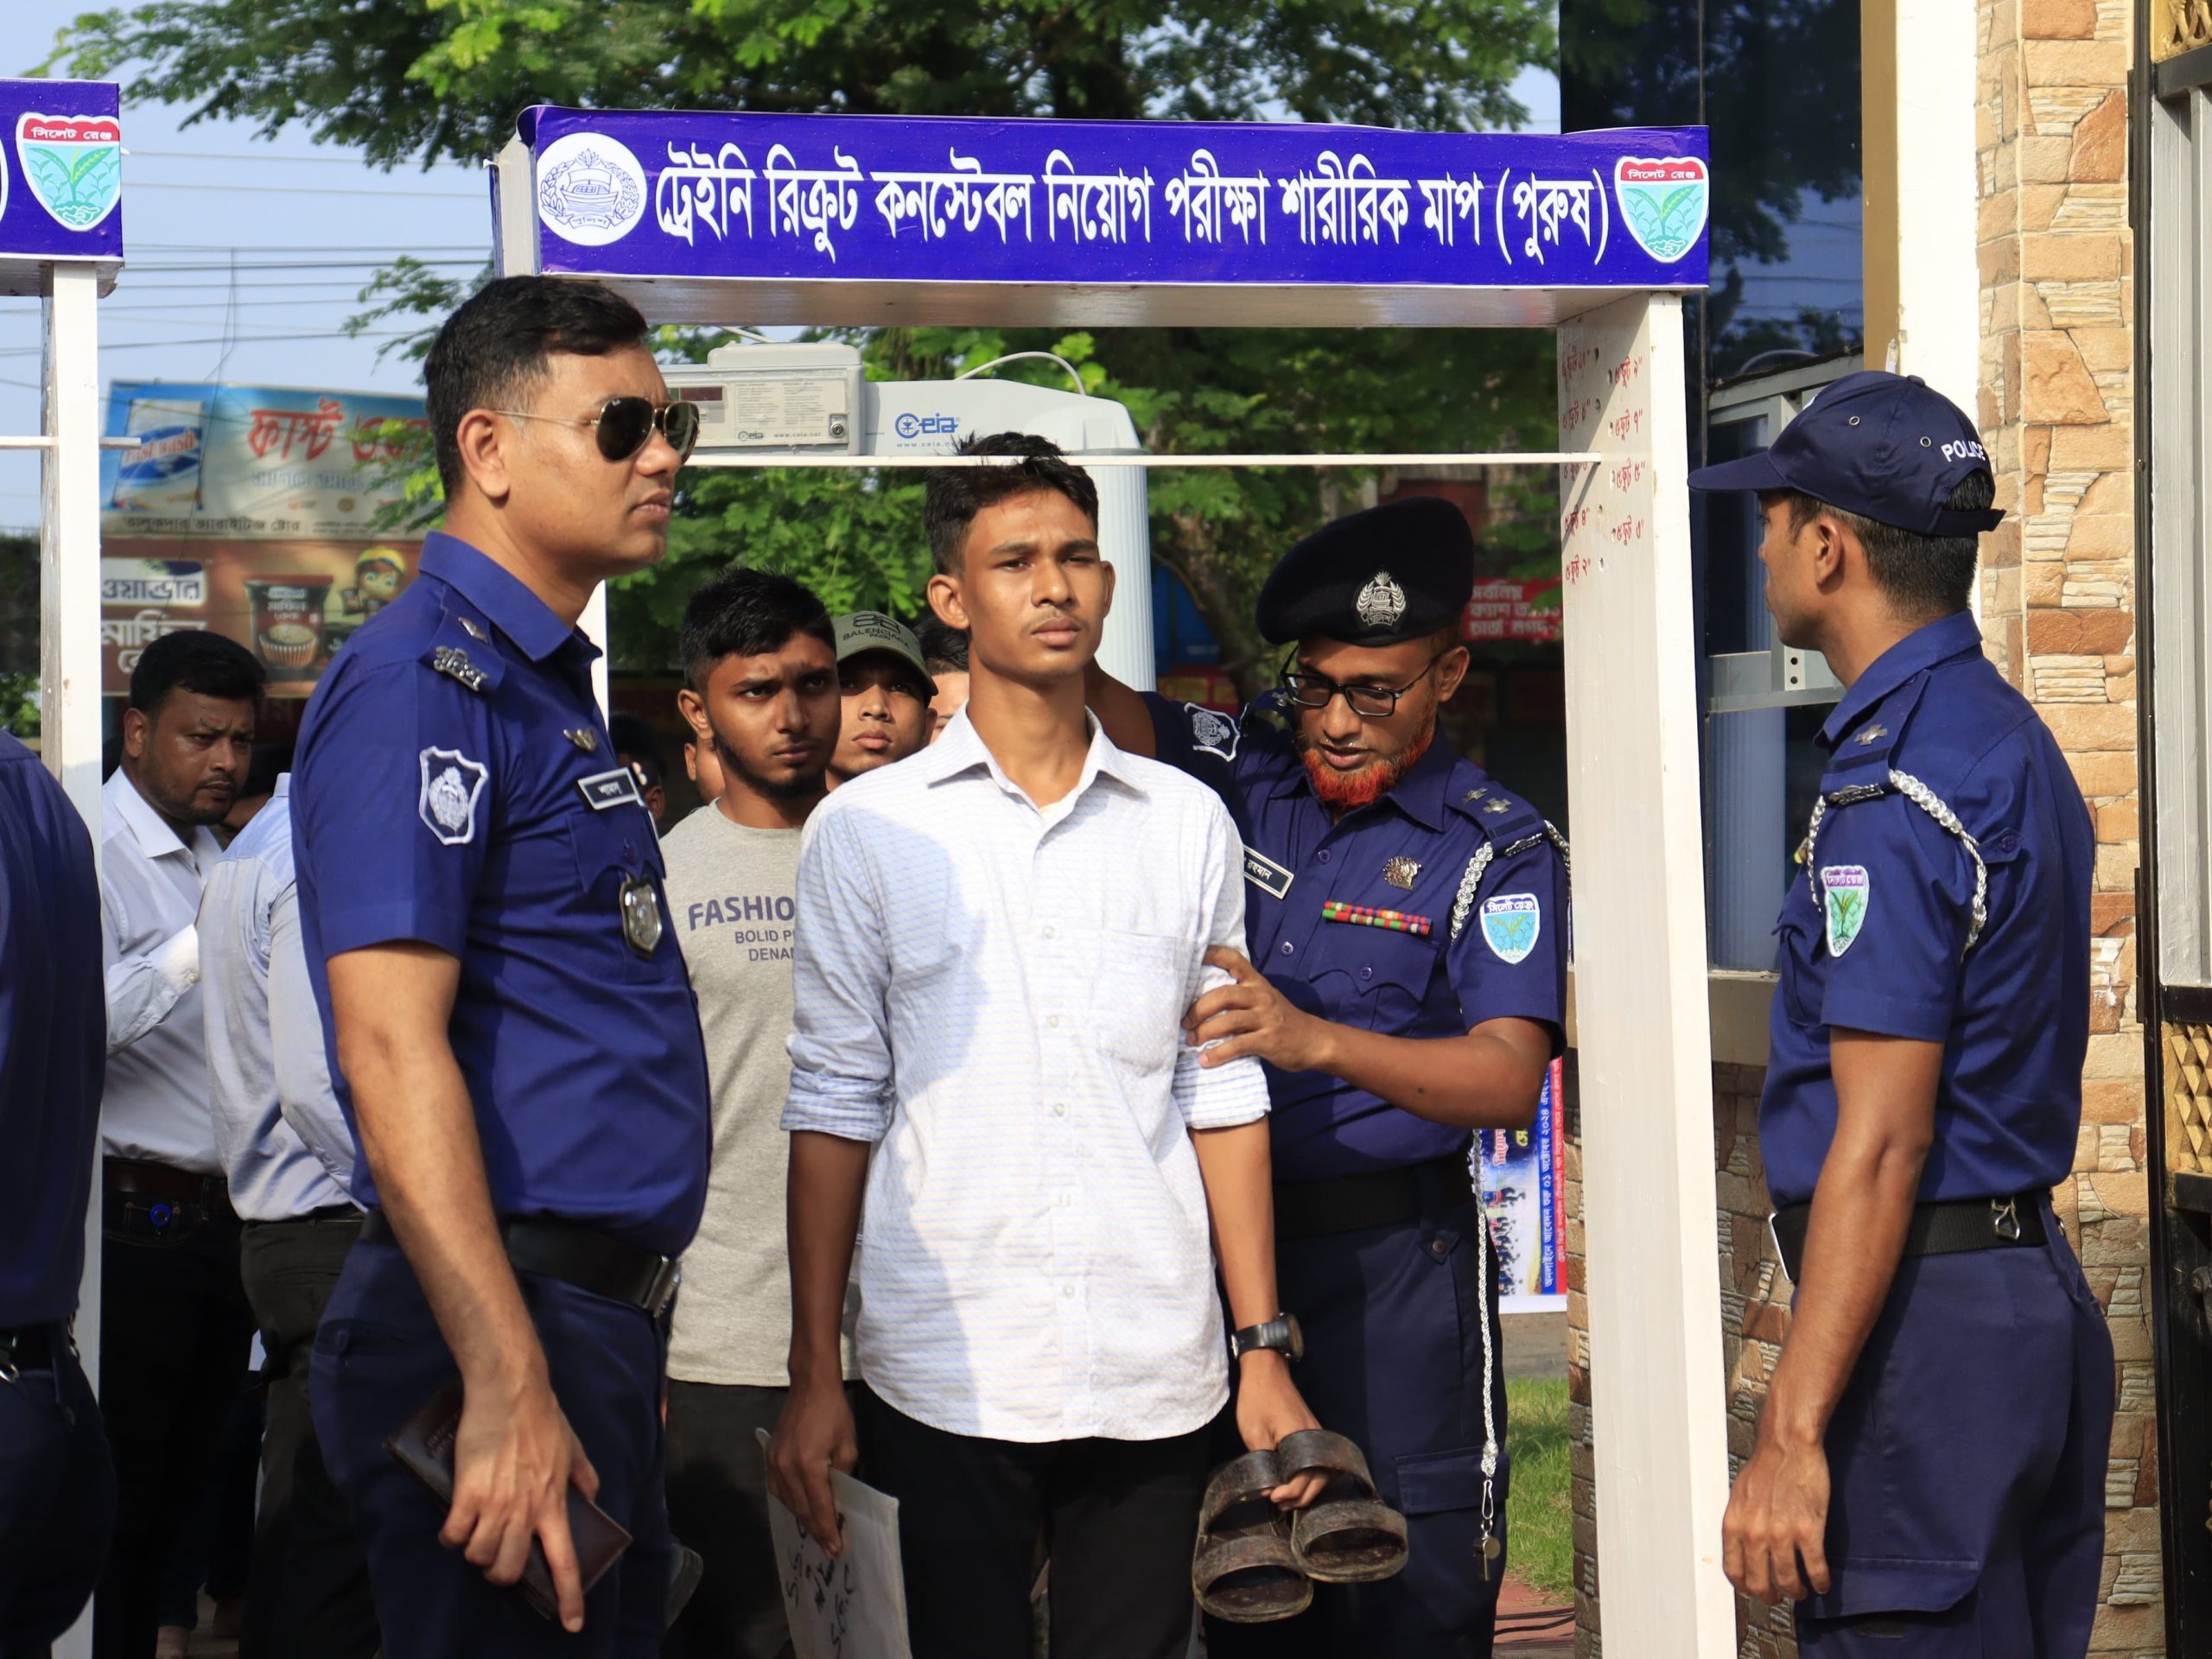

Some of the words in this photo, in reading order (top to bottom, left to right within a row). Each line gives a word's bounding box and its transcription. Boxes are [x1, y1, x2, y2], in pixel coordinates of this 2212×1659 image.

[31, 126, 78, 139] সিলেট
[1627, 168, 1667, 180] সিলেট
[656, 141, 757, 246] ট্রেইনি
[762, 144, 864, 263] রিক্রুট
[870, 147, 1035, 244] কনস্টেবল
[1042, 149, 1154, 244] নিয়োগ
[1165, 149, 1270, 245] পরীক্ষা
[1278, 151, 1411, 245] শারীরিক
[1417, 172, 1484, 246] মাপ
[1497, 168, 1608, 264] (পুরুষ)
[1941, 439, 1986, 462] POLICE
[688, 895, 795, 931] FASHIO
[734, 929, 779, 944] BOLID
[783, 930, 795, 942] P
[748, 947, 795, 962] DENA
[1541, 1109, 1552, 1135] ২০২৪
